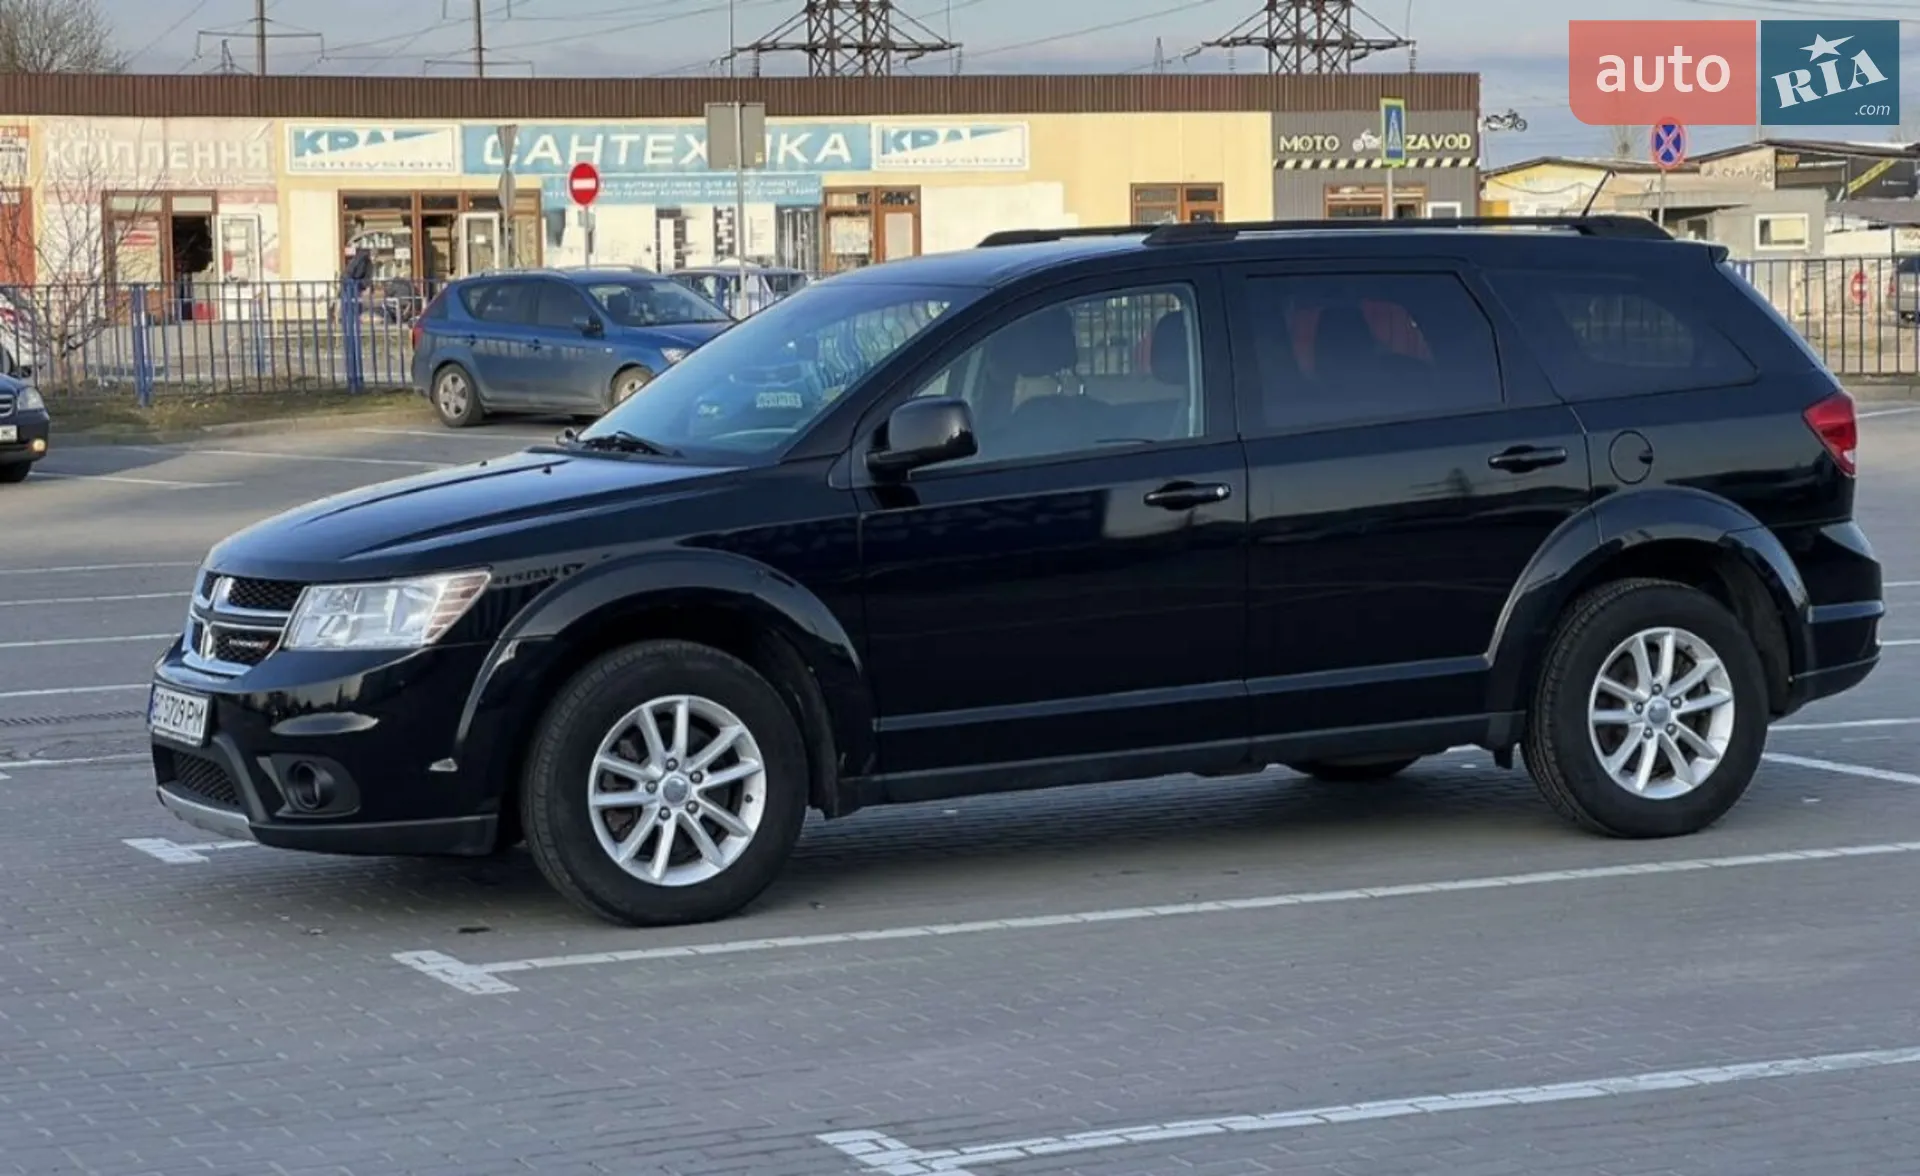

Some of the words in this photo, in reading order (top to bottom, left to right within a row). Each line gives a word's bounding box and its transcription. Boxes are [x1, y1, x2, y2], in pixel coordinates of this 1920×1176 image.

[483, 133, 853, 166] САНТЕХІКА
[1279, 134, 1340, 152] MOTO
[1405, 133, 1472, 151] ZAVOD
